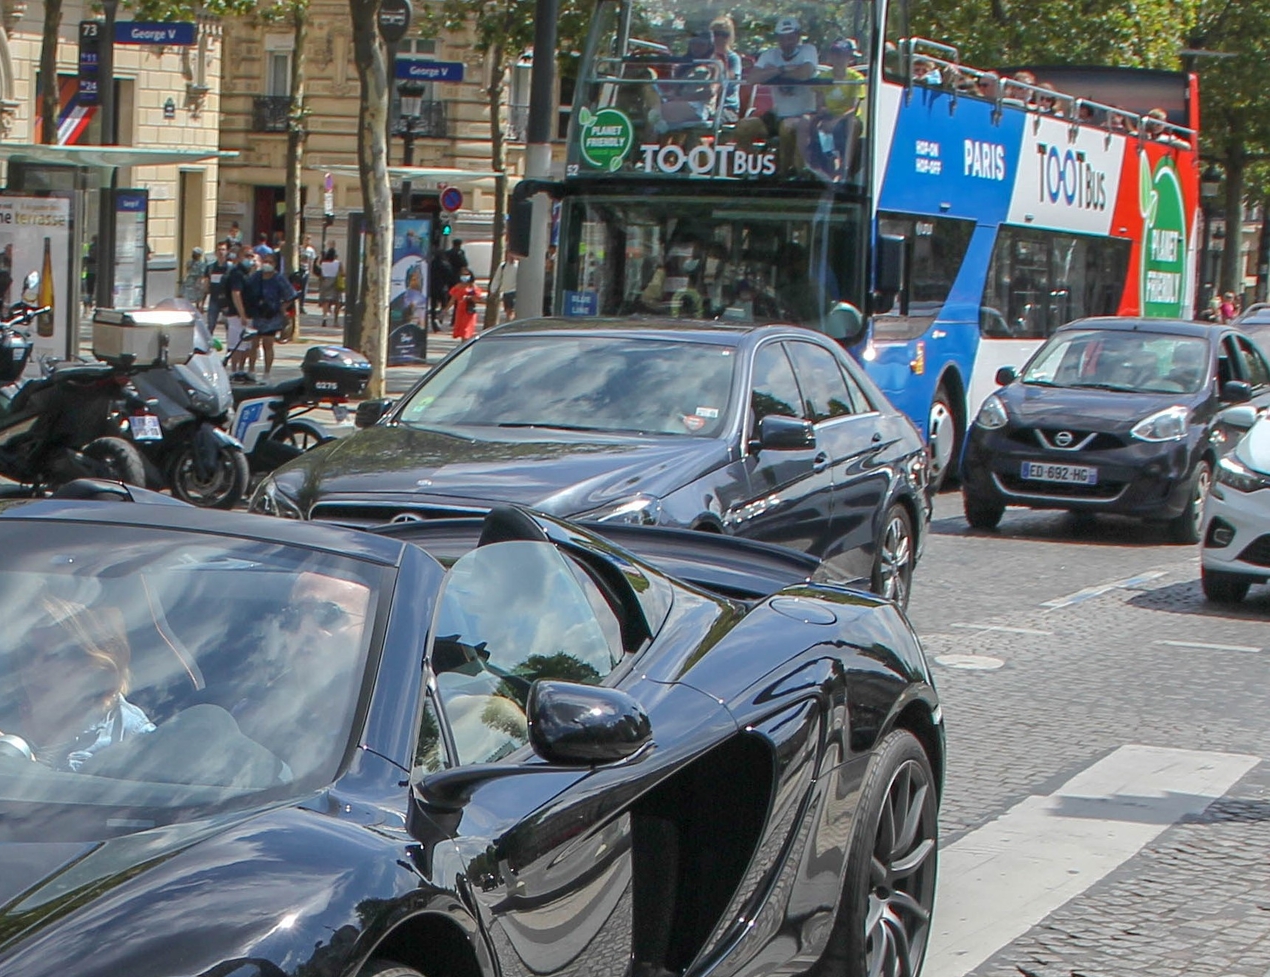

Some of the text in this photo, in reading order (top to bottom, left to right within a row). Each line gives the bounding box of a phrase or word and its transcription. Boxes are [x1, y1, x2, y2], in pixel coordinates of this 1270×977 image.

[83, 24, 98, 36] 73
[131, 29, 177, 41] George V
[409, 66, 449, 78] George V
[590, 125, 623, 136] PLANET
[585, 137, 626, 148] FRIENDLY
[963, 139, 1005, 181] PARIS
[566, 164, 580, 177] 52
[15, 211, 66, 227] terrasse
[1030, 464, 1088, 481] ED-692-HG
